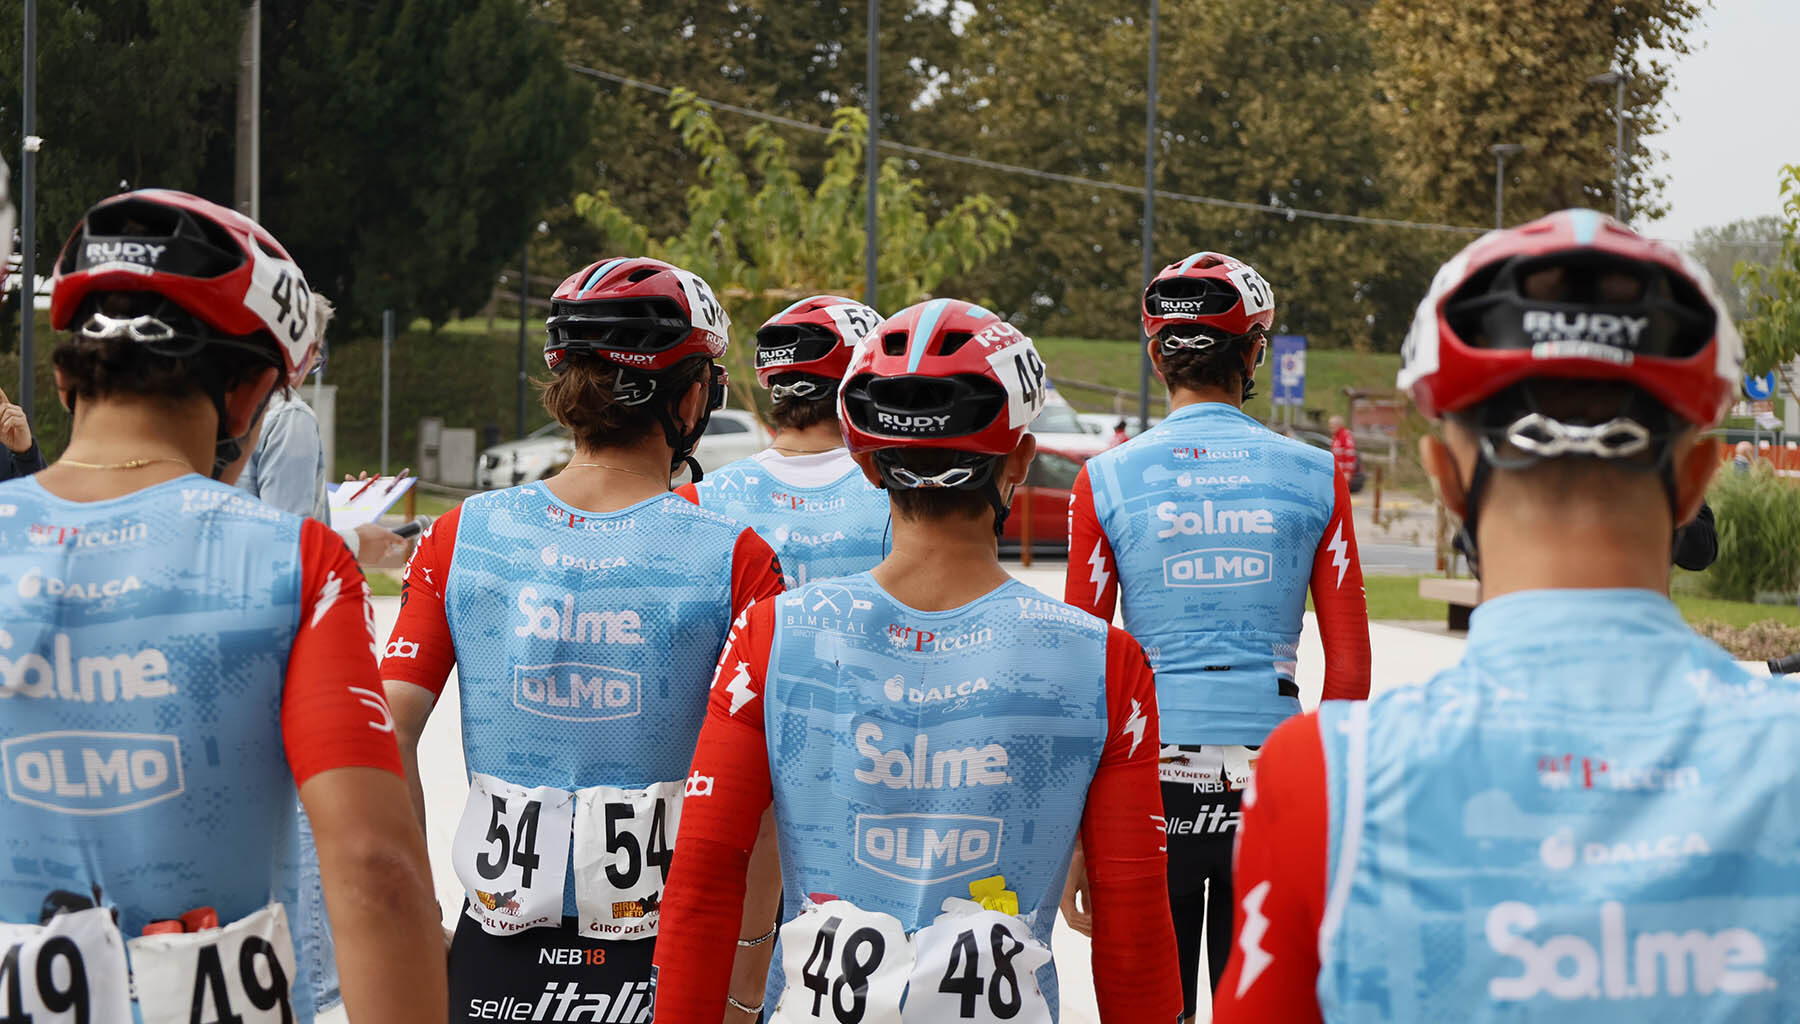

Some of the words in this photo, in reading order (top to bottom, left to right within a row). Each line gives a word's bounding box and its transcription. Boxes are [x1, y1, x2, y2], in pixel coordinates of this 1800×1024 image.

[86, 243, 166, 258] RUDY
[272, 268, 309, 342] 49
[1161, 301, 1204, 309] RUDY
[1523, 310, 1648, 336] RUDY
[706, 332, 726, 348] RUD
[974, 323, 1015, 348] RU
[610, 352, 656, 361] RUDY
[760, 347, 797, 359] RUDY
[878, 412, 950, 426] RUDY
[884, 424, 945, 433] PROJECT
[1193, 448, 1250, 459] Piccin
[1195, 475, 1250, 484] DALCA
[790, 496, 846, 513] Piccin
[56, 519, 147, 547] Piccin
[791, 530, 845, 546] DALCA
[561, 555, 628, 571] DALCA
[1172, 556, 1265, 580] OLMO
[47, 575, 141, 599] DALCA
[787, 615, 867, 634] BIMETAL
[914, 623, 993, 653] Piccin
[522, 673, 631, 709] OLMO
[908, 677, 990, 703] DALCA
[16, 748, 169, 798] OLMO
[1174, 770, 1210, 779] VENETO
[1193, 781, 1240, 794] NEB1
[476, 794, 542, 889] 54
[604, 798, 674, 890] 54
[864, 826, 990, 870] OLMO
[1583, 833, 1712, 865] DALCA
[613, 902, 636, 912] GIRO
[590, 922, 621, 933] GIRO
[624, 925, 645, 934] DEL
[538, 948, 606, 965] NEB18
[0, 936, 92, 1024] 49
[190, 935, 293, 1024] 49
[802, 916, 885, 1024] 48
[938, 923, 1024, 1020] 48
